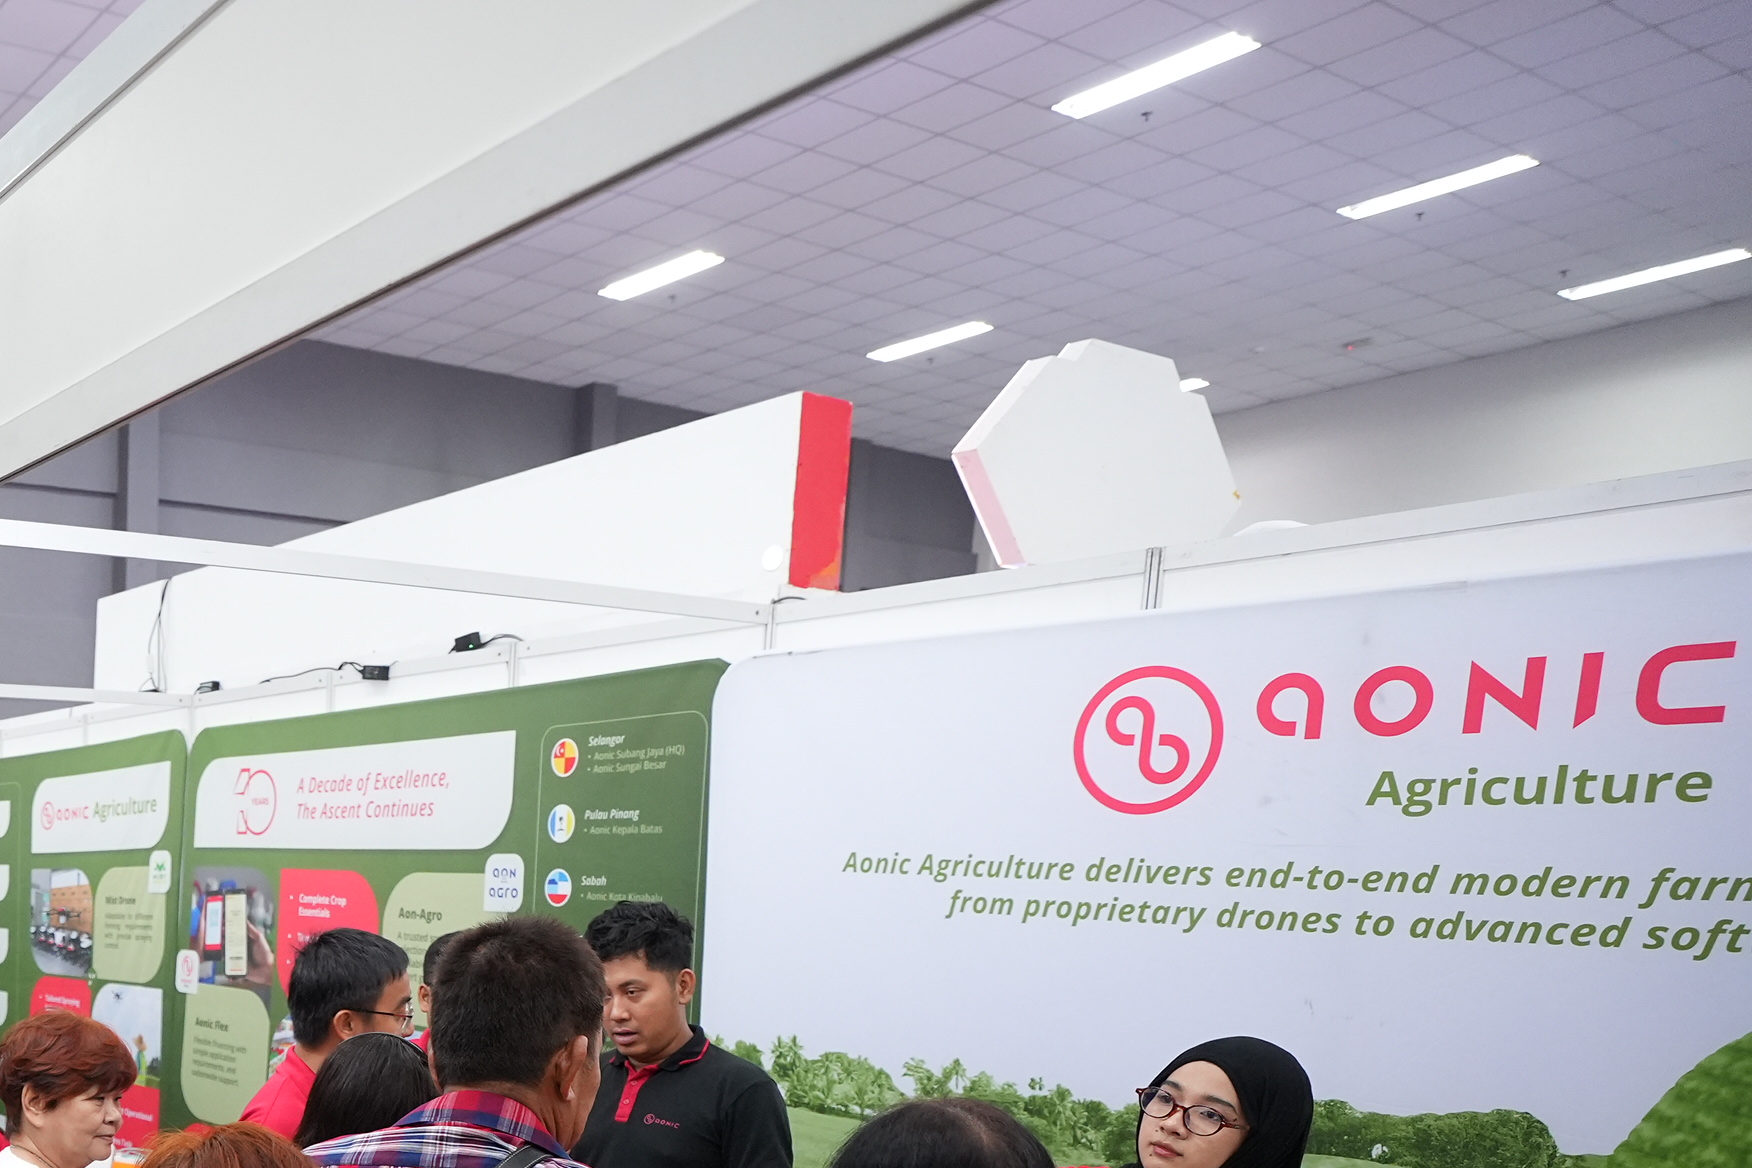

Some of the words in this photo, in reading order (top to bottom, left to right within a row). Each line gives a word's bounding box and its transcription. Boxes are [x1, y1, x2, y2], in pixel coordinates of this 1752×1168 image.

[588, 735, 626, 748] Selangor
[593, 751, 615, 761] Aonic
[616, 749, 646, 760] Subang
[646, 747, 664, 759] Jaya
[665, 744, 686, 757] (HQ)
[592, 764, 614, 774] Aonic
[615, 762, 642, 774] Sungai
[643, 760, 666, 771] Besar
[296, 777, 305, 794] A
[308, 775, 353, 794] Decade
[356, 772, 371, 797] of
[373, 770, 450, 791] Excellence,
[1365, 763, 1714, 818] Agriculture
[93, 797, 158, 823] Agriculture
[296, 803, 317, 820] The
[319, 801, 361, 820] Ascent
[365, 799, 435, 818] Continues
[584, 809, 608, 820] Pulau
[610, 808, 640, 821] Pinang
[589, 826, 611, 835] Aonic
[612, 825, 639, 836] Kepala
[640, 824, 663, 835] Batas
[580, 875, 607, 886] Sabah
[842, 851, 910, 875] Aonic
[917, 853, 1076, 883] Agriculture
[1084, 856, 1214, 886] delivers
[1224, 861, 1440, 895] end-to-end
[1449, 866, 1632, 901] modern
[299, 893, 330, 907] Complete
[330, 895, 347, 908] Crop
[298, 906, 331, 918] Essentials
[398, 907, 443, 924] Aon-Agro
[945, 889, 1014, 919] from
[1021, 896, 1208, 934] proprietary
[1216, 901, 1342, 934] drones
[1354, 909, 1396, 937] to
[1408, 910, 1633, 949] advanced
[194, 1017, 214, 1029] Aonic
[214, 1020, 229, 1032] Flex
